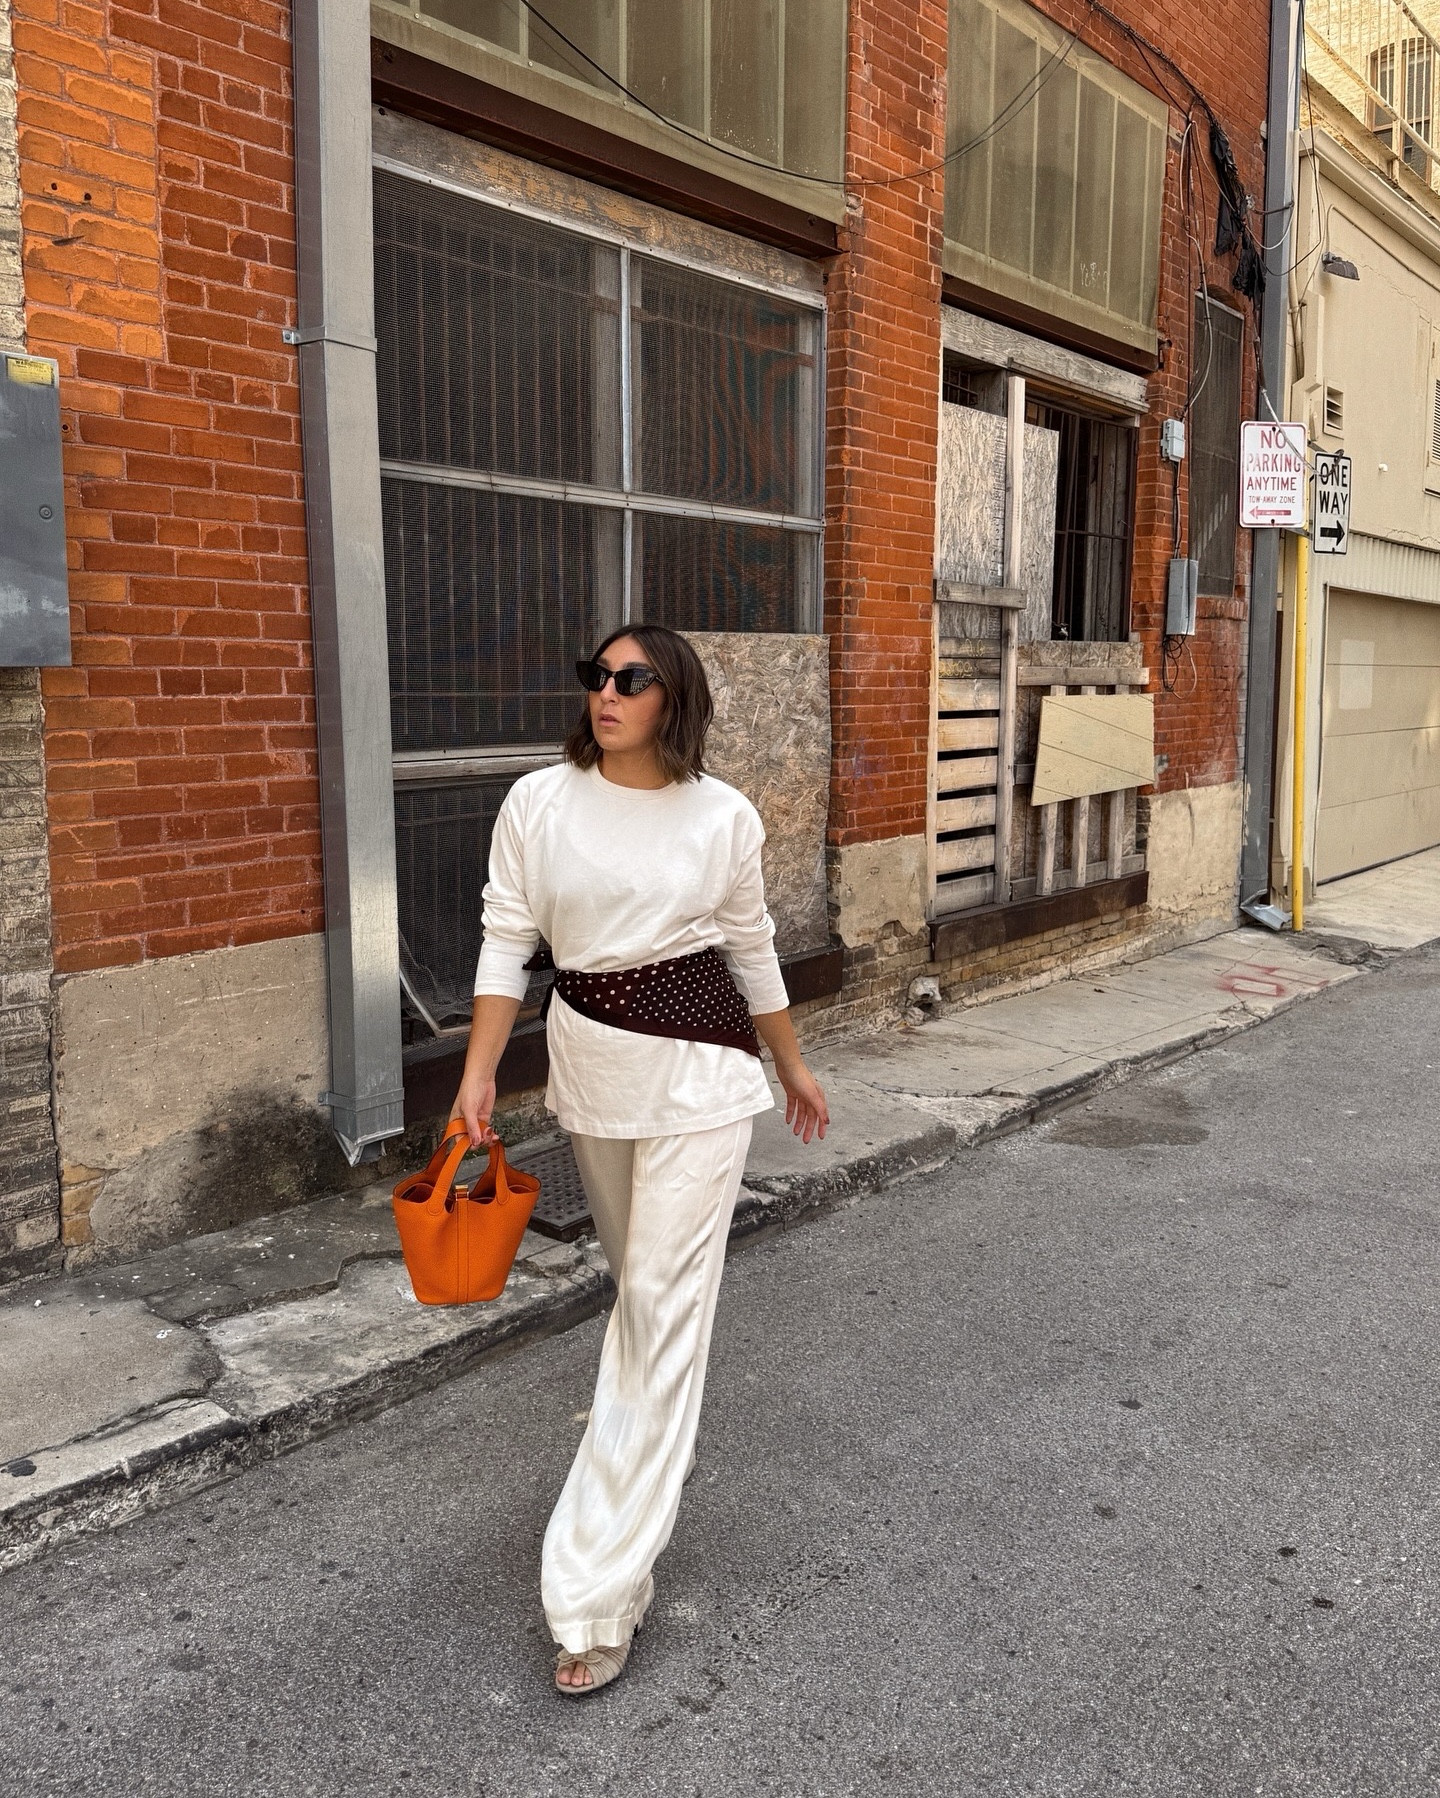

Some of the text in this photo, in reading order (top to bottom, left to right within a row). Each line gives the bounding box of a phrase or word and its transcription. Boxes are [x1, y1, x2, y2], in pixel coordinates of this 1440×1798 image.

[1261, 430, 1287, 449] NO
[1246, 453, 1301, 473] PARKING
[1246, 477, 1297, 491] ANYTIME
[1320, 462, 1348, 488] ONE
[1279, 495, 1296, 504] ZONE
[1319, 490, 1348, 515] WAY
